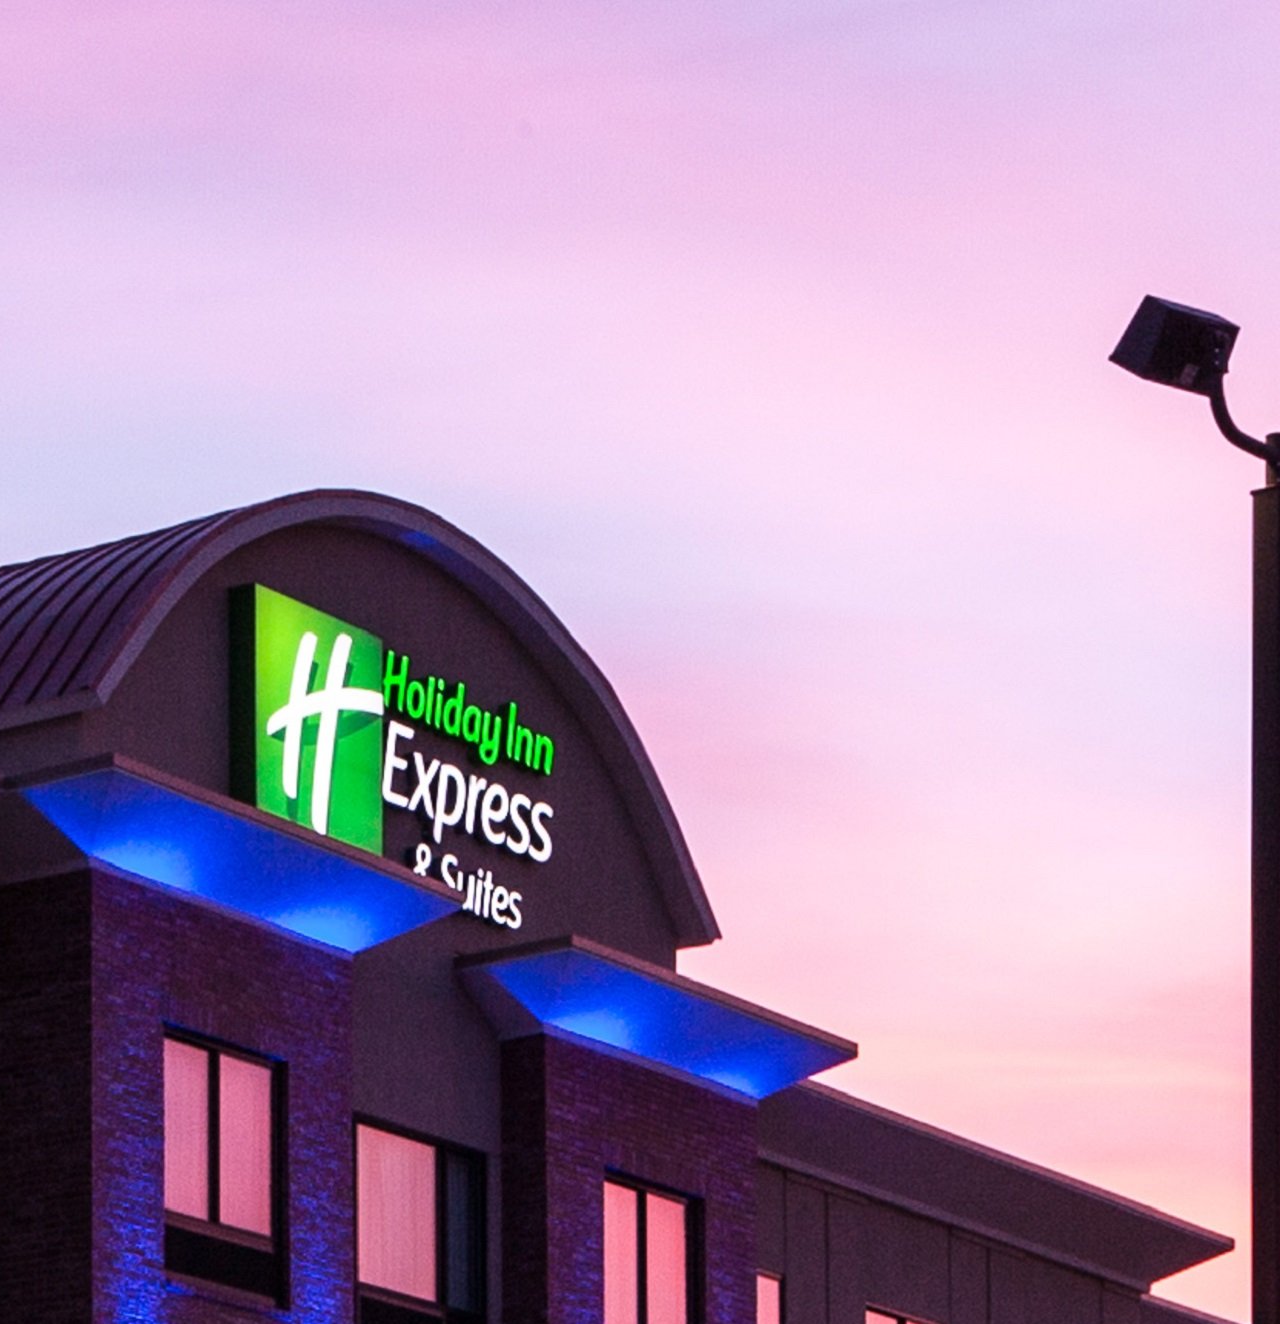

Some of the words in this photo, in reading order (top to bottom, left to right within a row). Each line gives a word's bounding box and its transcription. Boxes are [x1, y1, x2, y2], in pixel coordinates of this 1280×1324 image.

[383, 650, 501, 766] Holiday
[506, 702, 554, 776] Inn
[381, 719, 554, 863] Express
